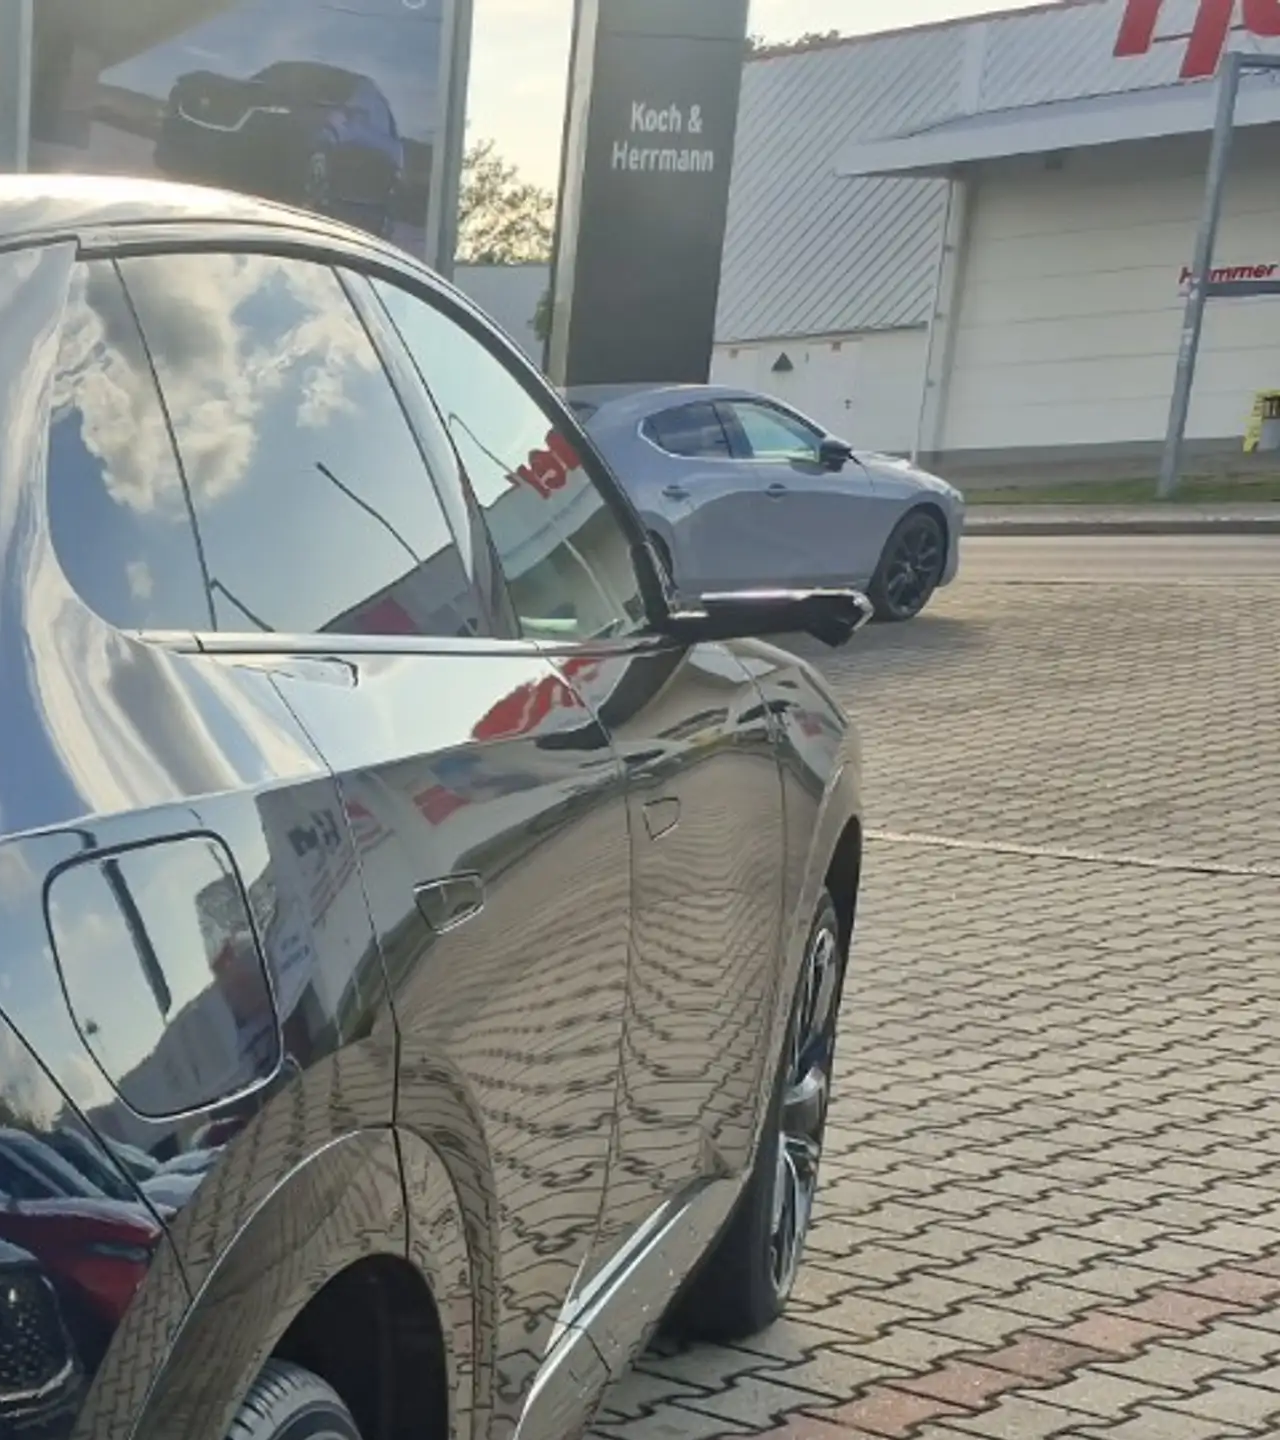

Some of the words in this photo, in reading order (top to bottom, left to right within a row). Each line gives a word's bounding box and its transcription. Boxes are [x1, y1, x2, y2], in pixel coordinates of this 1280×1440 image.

[630, 100, 682, 132] Koch
[687, 103, 703, 133] &
[612, 140, 715, 172] Herrmann
